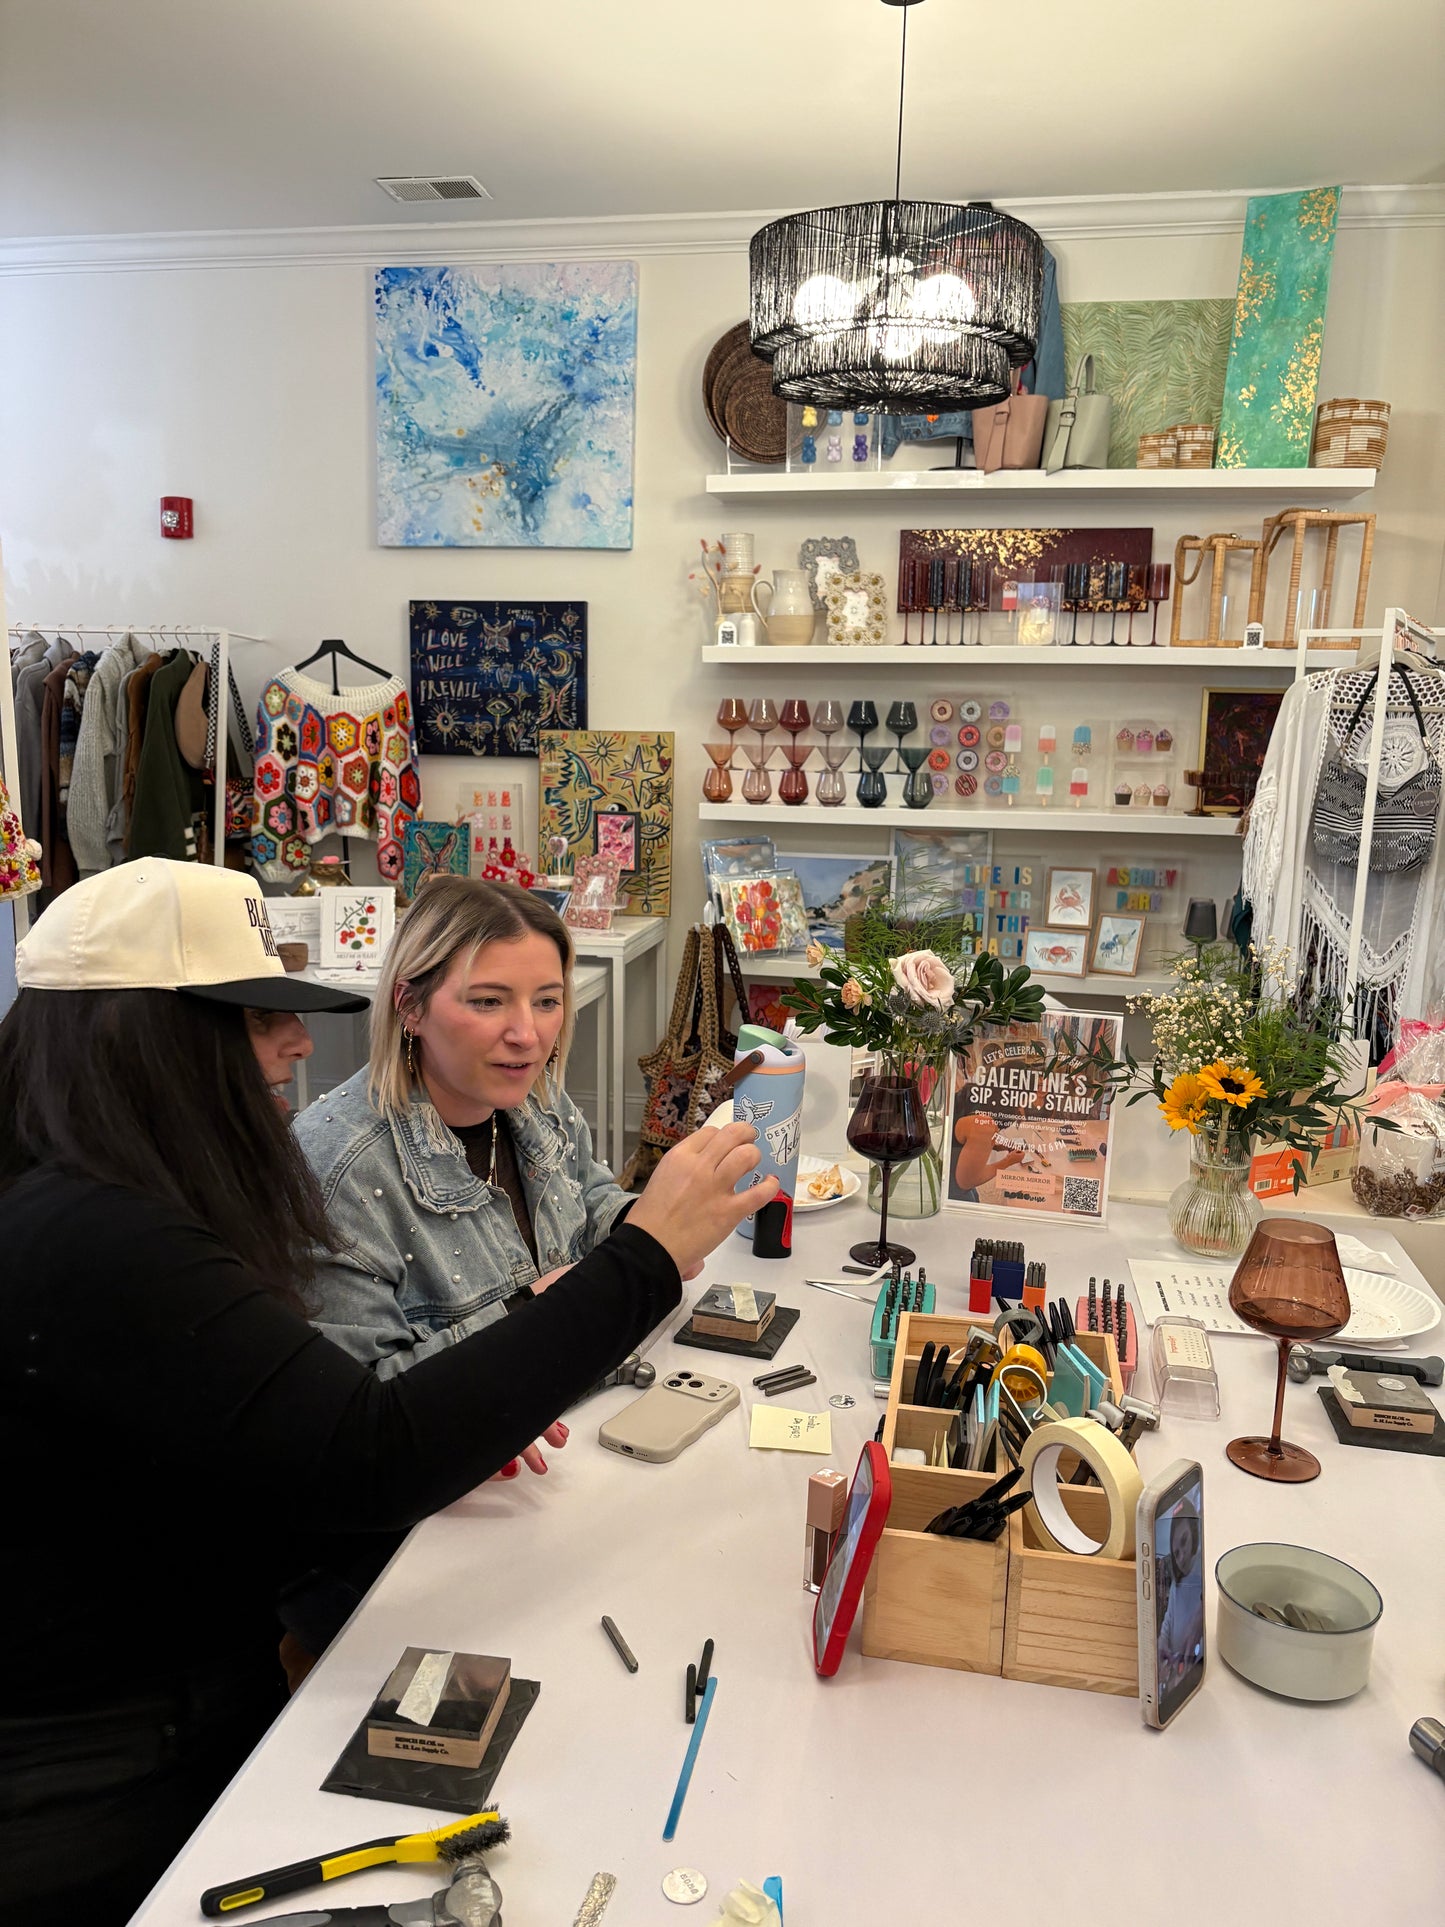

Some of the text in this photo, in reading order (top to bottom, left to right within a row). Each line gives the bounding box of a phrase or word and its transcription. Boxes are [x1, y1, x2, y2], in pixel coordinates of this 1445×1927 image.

[427, 629, 469, 650] LOVE
[572, 629, 583, 659] LOVE
[428, 654, 464, 673] WILL
[420, 680, 482, 704] PREVAIL
[964, 864, 1033, 885] LIFE IS
[1107, 867, 1177, 887] ASBURY
[962, 888, 1032, 909] BETTER
[1116, 891, 1162, 913] PARK
[962, 913, 1030, 933] AT THE
[983, 1048, 1004, 1064] LET'S
[1004, 1044, 1046, 1057] CELEBRAE
[974, 1065, 1088, 1096] GALENTINE'S
[1044, 1093, 1096, 1115] STAMP
[975, 1109, 986, 1118] Pop
[1027, 1116, 1046, 1124] stamp
[980, 1118, 990, 1126] get
[1035, 1124, 1056, 1133] during
[991, 1132, 1027, 1152] FEBRUARY
[1037, 1143, 1047, 1153] AT
[1048, 1142, 1054, 1152] 6
[1054, 1139, 1066, 1150] PM
[1026, 1176, 1051, 1184] MIRROR
